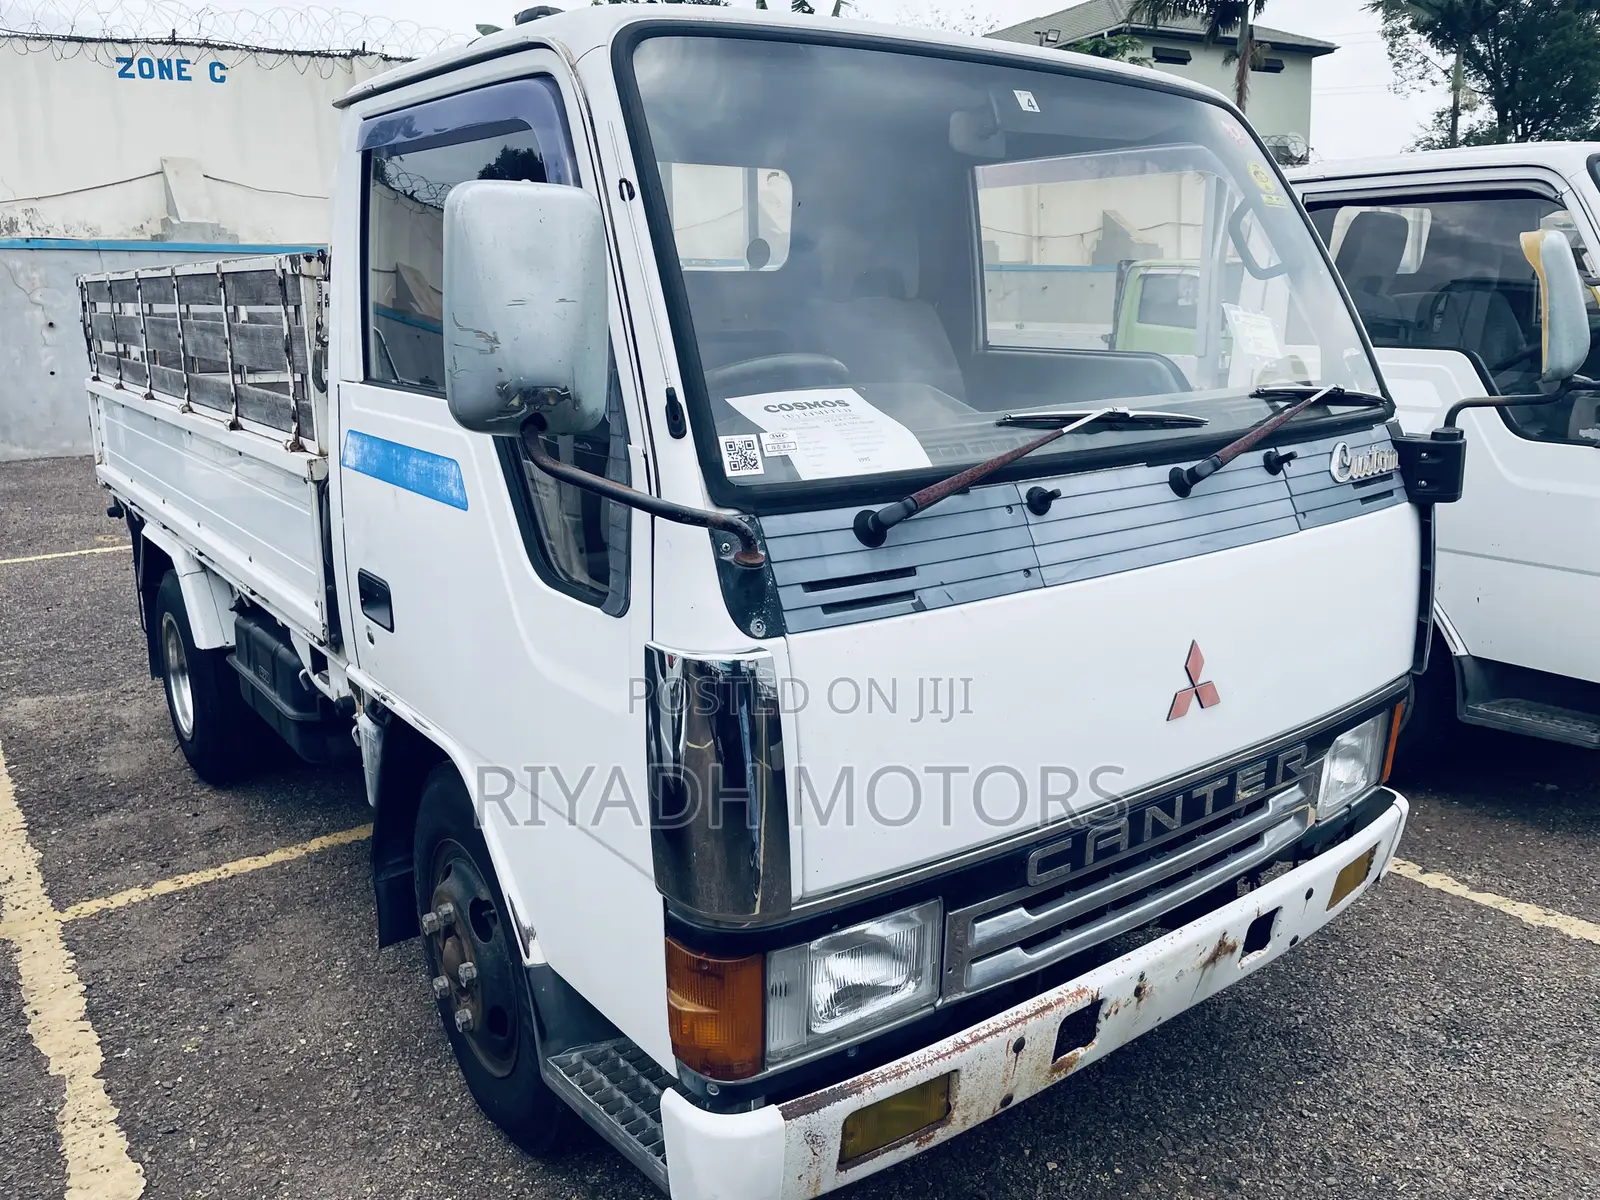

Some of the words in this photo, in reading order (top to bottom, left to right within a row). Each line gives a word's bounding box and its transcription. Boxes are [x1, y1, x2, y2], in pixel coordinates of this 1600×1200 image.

[115, 56, 192, 81] ZONE
[209, 61, 227, 83] C
[1027, 98, 1036, 110] 4
[763, 399, 850, 413] COSMOS
[1330, 441, 1400, 483] Custom
[1027, 744, 1308, 887] CANTER
